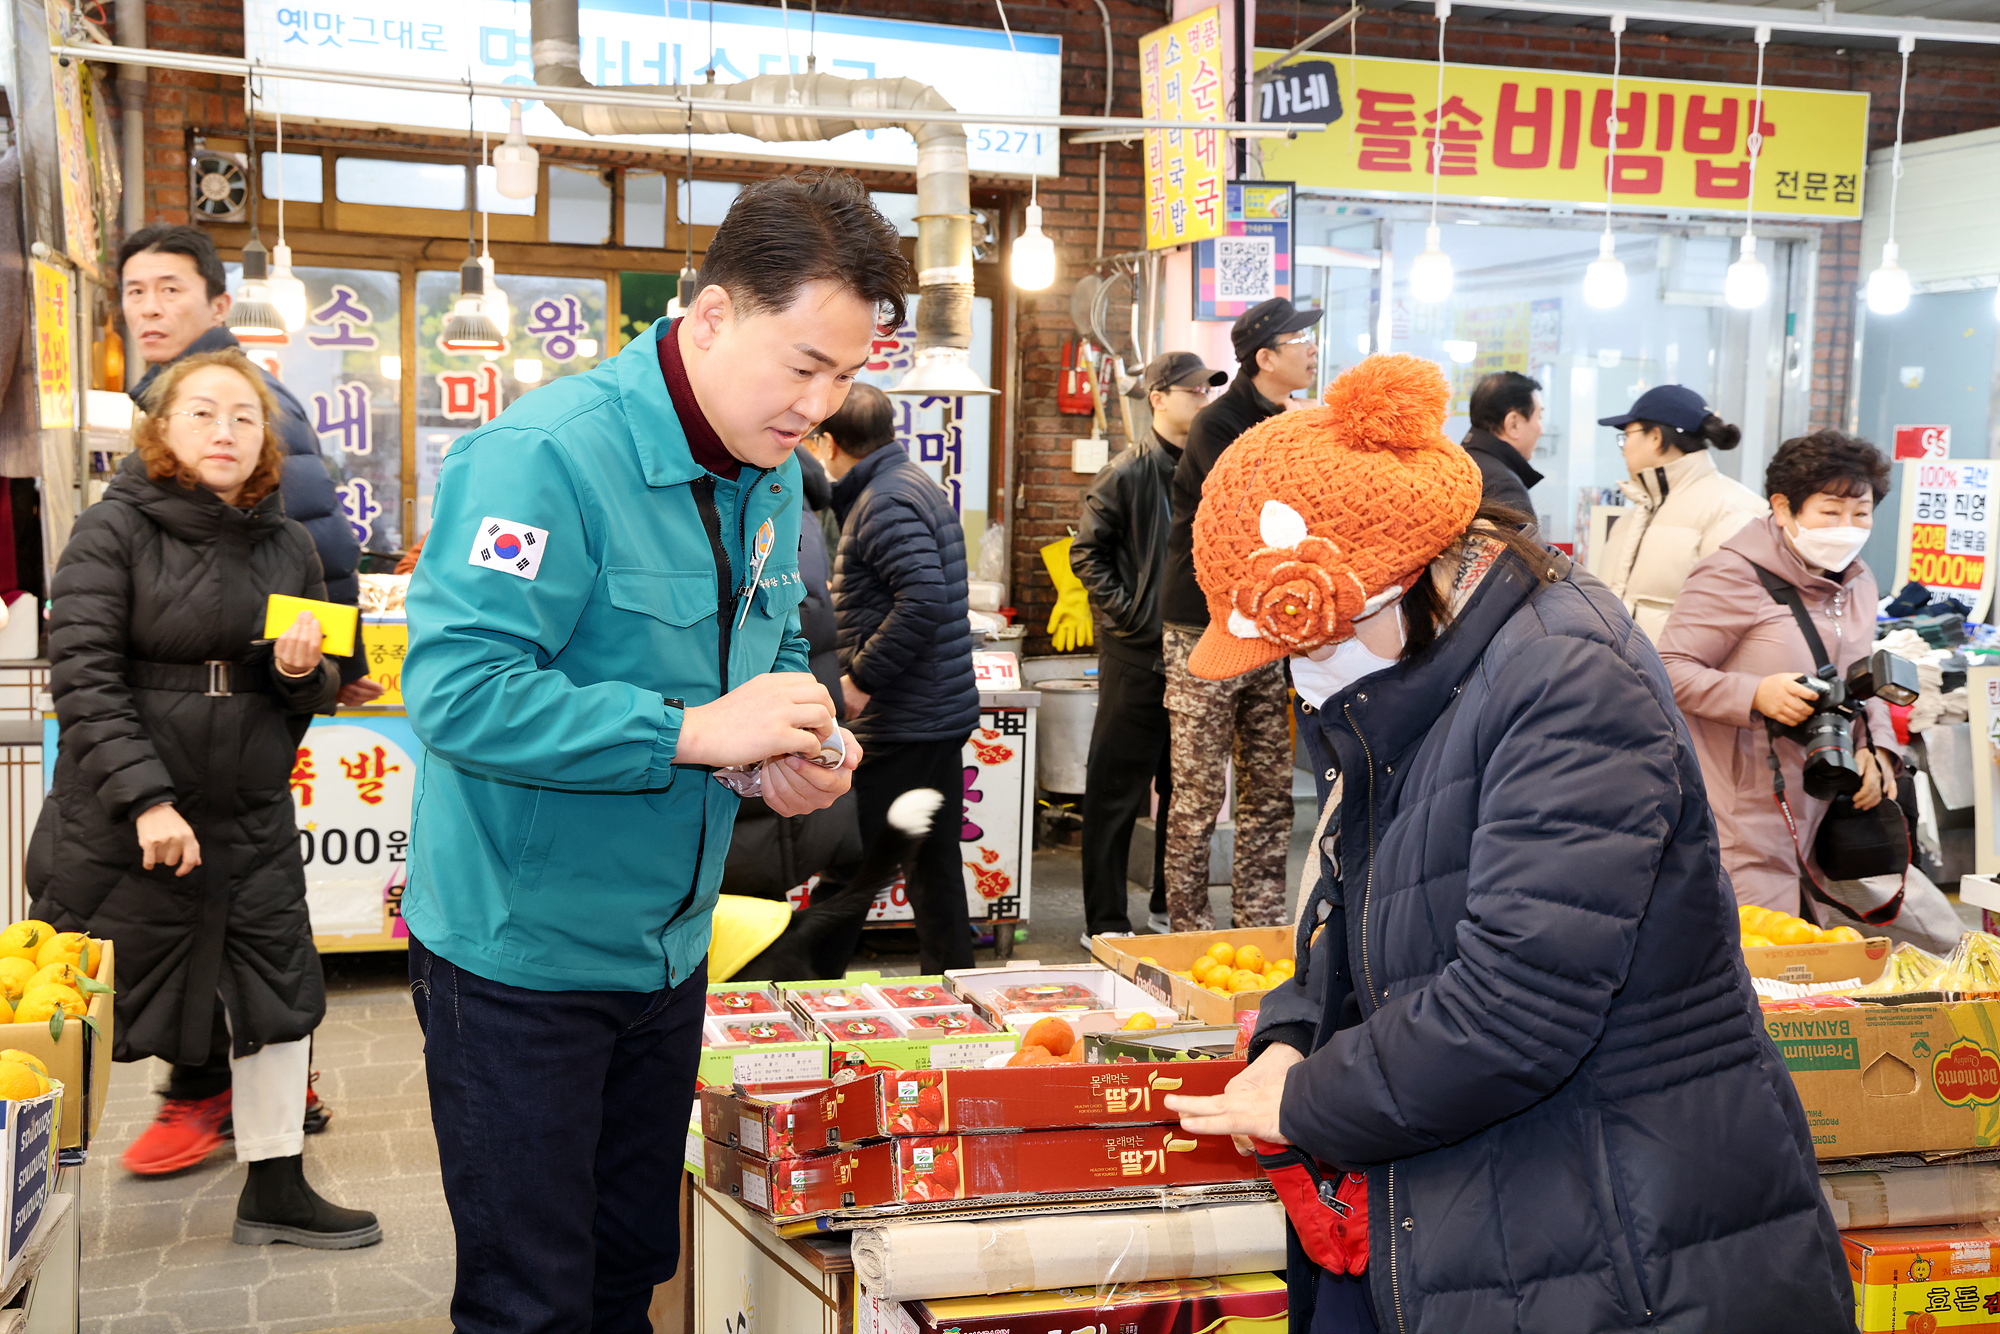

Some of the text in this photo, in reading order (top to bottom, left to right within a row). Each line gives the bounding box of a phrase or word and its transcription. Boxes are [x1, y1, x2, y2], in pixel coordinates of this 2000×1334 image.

[277, 7, 448, 53] 옛맛그대로
[1188, 18, 1218, 55] 명품
[1191, 60, 1220, 229] 순대국
[1775, 170, 1857, 204] 전문점
[1919, 465, 1988, 489] 100% 국산
[1917, 492, 1948, 520] 공장
[1768, 1019, 1850, 1039] BANANAS
[1783, 1043, 1854, 1061] Premium
[1953, 1055, 1980, 1067] Quality
[1090, 1073, 1130, 1096] 몰래먹는
[1937, 1068, 1999, 1087] Del Monte
[1104, 1085, 1151, 1113] 딸기
[1105, 1135, 1145, 1159] 몰래먹는
[17, 1144, 49, 1193] Bananas
[1120, 1148, 1166, 1176] 딸기
[1925, 1286, 1980, 1314] 효돈
